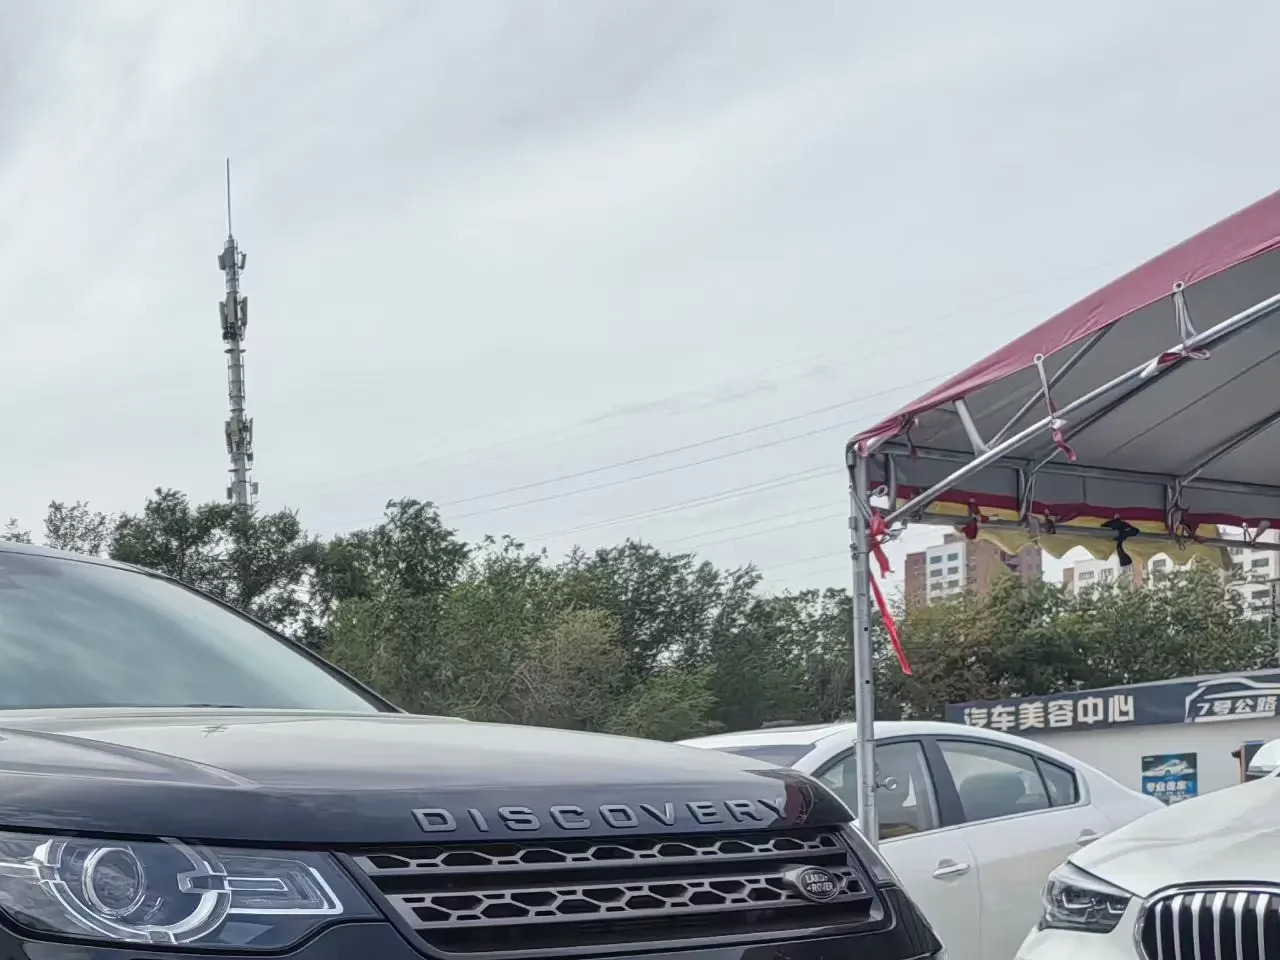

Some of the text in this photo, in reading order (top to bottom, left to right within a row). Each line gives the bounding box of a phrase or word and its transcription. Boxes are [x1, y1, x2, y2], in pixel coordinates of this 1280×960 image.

[964, 695, 1135, 732] 汽车美容中心
[412, 798, 787, 832] DISCOVERY
[805, 873, 825, 883] LAND
[811, 882, 834, 893] ROVER
